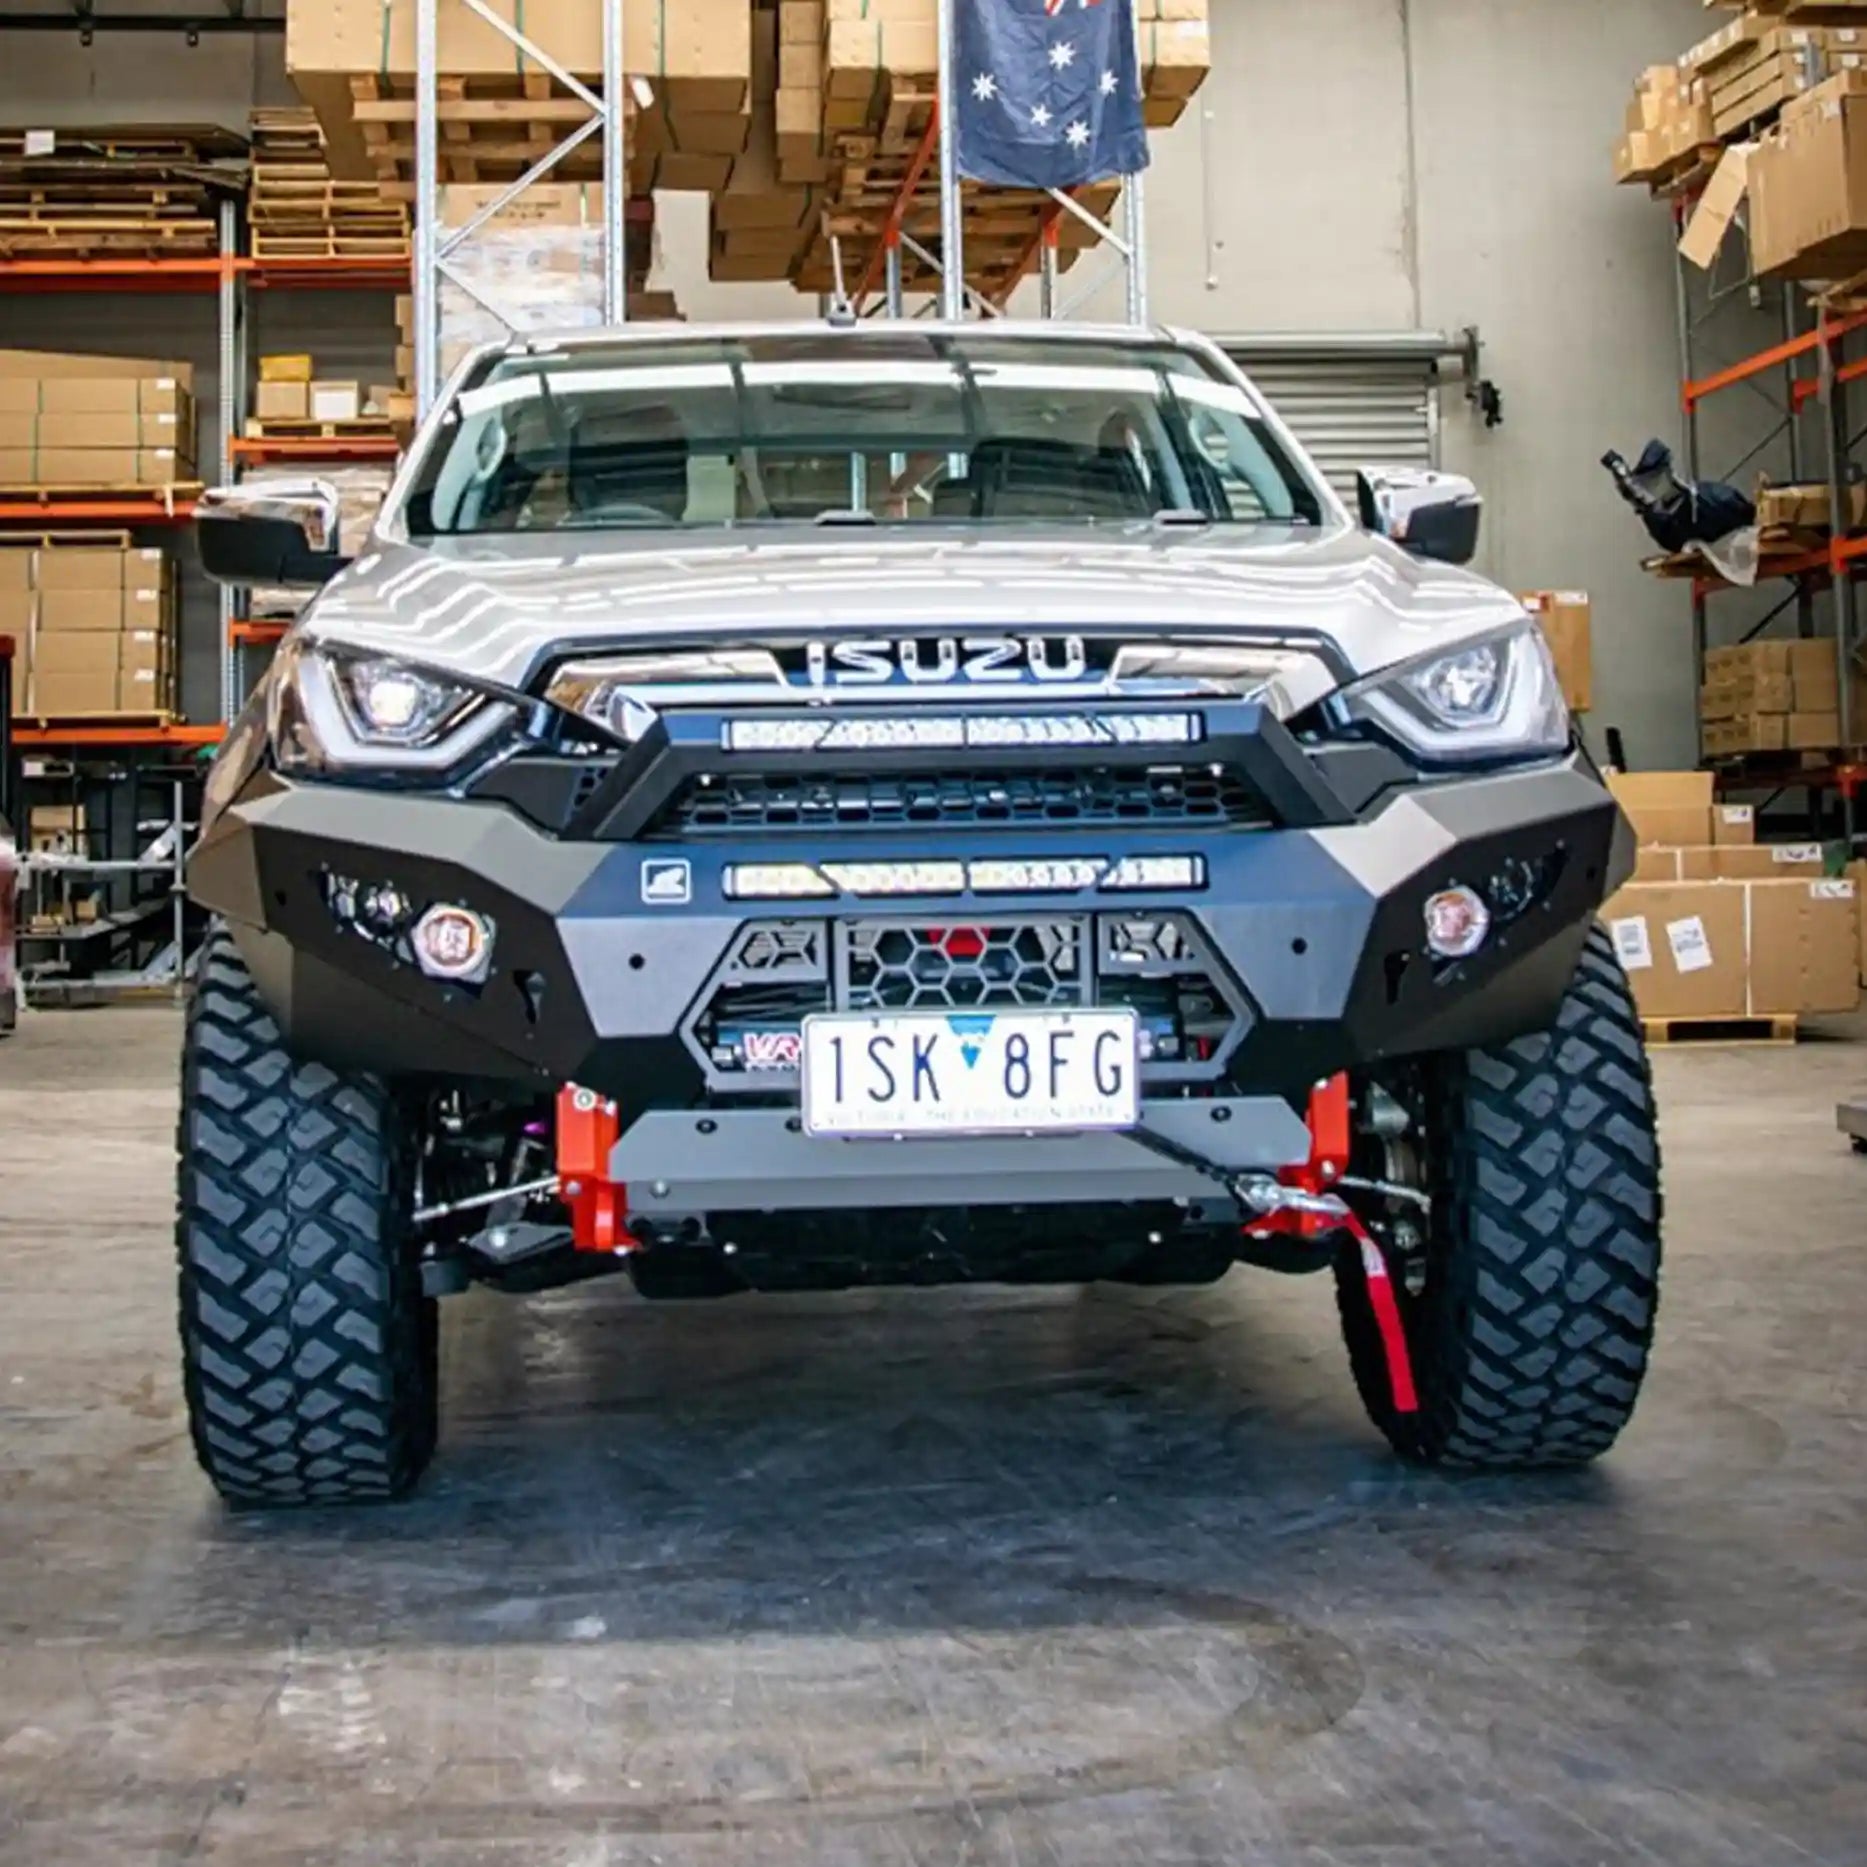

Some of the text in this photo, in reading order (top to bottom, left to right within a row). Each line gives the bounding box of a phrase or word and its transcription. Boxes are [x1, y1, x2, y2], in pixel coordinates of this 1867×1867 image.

[806, 635, 1085, 685] ISUZU
[743, 1032, 801, 1061] VR
[829, 1030, 1122, 1103] 1SK 8FG
